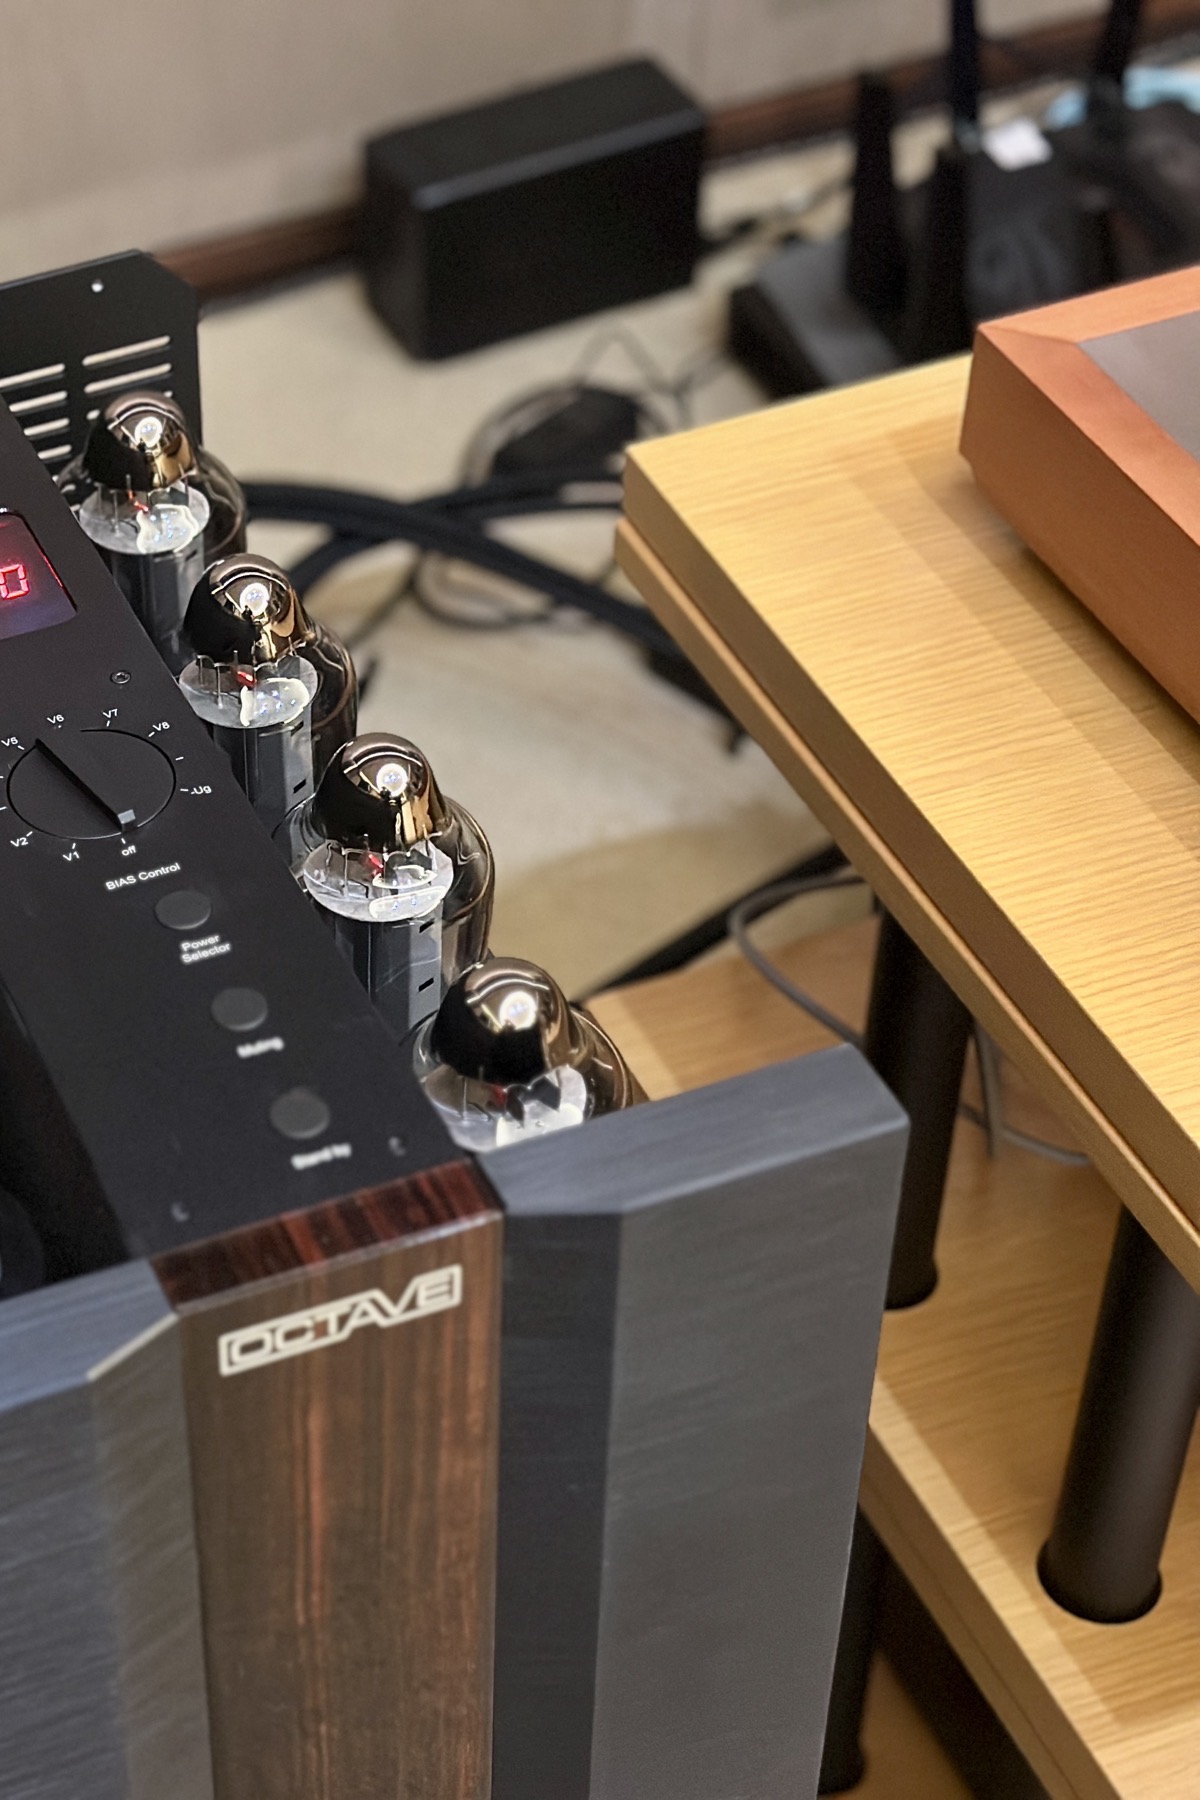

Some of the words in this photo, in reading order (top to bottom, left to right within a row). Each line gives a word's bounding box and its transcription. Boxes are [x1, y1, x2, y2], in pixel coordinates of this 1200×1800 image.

[46, 713, 64, 724] V6
[102, 708, 119, 719] V7
[153, 721, 170, 732] V8
[1, 736, 18, 747] V5
[10, 837, 28, 848] V2
[63, 851, 80, 862] V1
[121, 845, 137, 857] off
[105, 874, 136, 890] BIAS
[138, 862, 181, 881] Control
[181, 934, 220, 952] Power
[181, 943, 231, 964] Selector
[218, 1264, 462, 1376] OCTAVE
